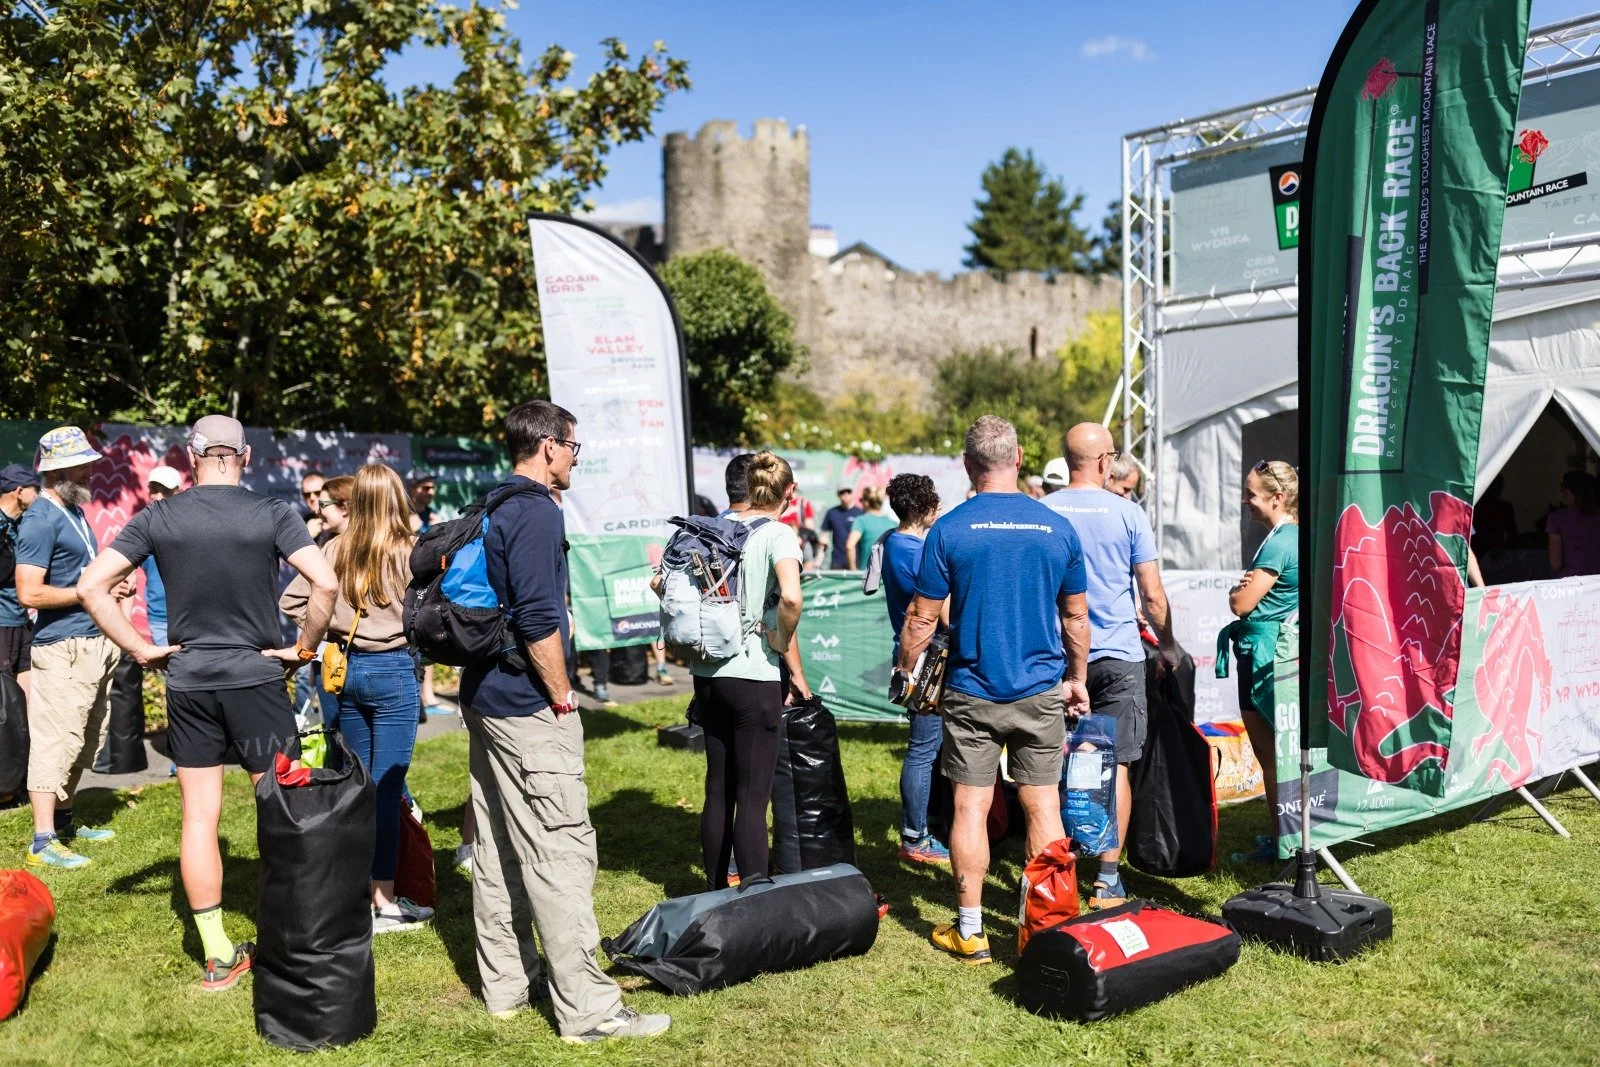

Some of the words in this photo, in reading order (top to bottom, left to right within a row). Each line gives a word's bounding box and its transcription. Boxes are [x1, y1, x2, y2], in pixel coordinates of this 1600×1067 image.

[1426, 22, 1437, 54] RACE
[1422, 56, 1435, 121] MOUNTAIN
[1421, 123, 1432, 188] TOUGHEST
[1506, 187, 1544, 203] OUNTAIN
[1545, 179, 1569, 193] RACE
[1543, 197, 1581, 209] TAFF
[1420, 189, 1431, 242] WORLD'S
[1191, 235, 1250, 250] WYDDFA
[1419, 242, 1428, 266] THE
[545, 274, 600, 284] CADAIR
[546, 283, 585, 294] IDRIS
[594, 335, 636, 344] ELAN
[1351, 304, 1395, 456] DRAGON'S
[1374, 210, 1408, 292] BACK
[586, 345, 645, 355] VALLEY
[1386, 423, 1396, 458] RAS
[1391, 359, 1400, 409] CEFN
[1396, 245, 1415, 323] DDRAIG
[638, 399, 664, 407] PEN
[1541, 585, 1584, 601] CONWY
[807, 608, 830, 619] days
[1556, 687, 1570, 703] YR
[1576, 681, 1600, 697] WYD
